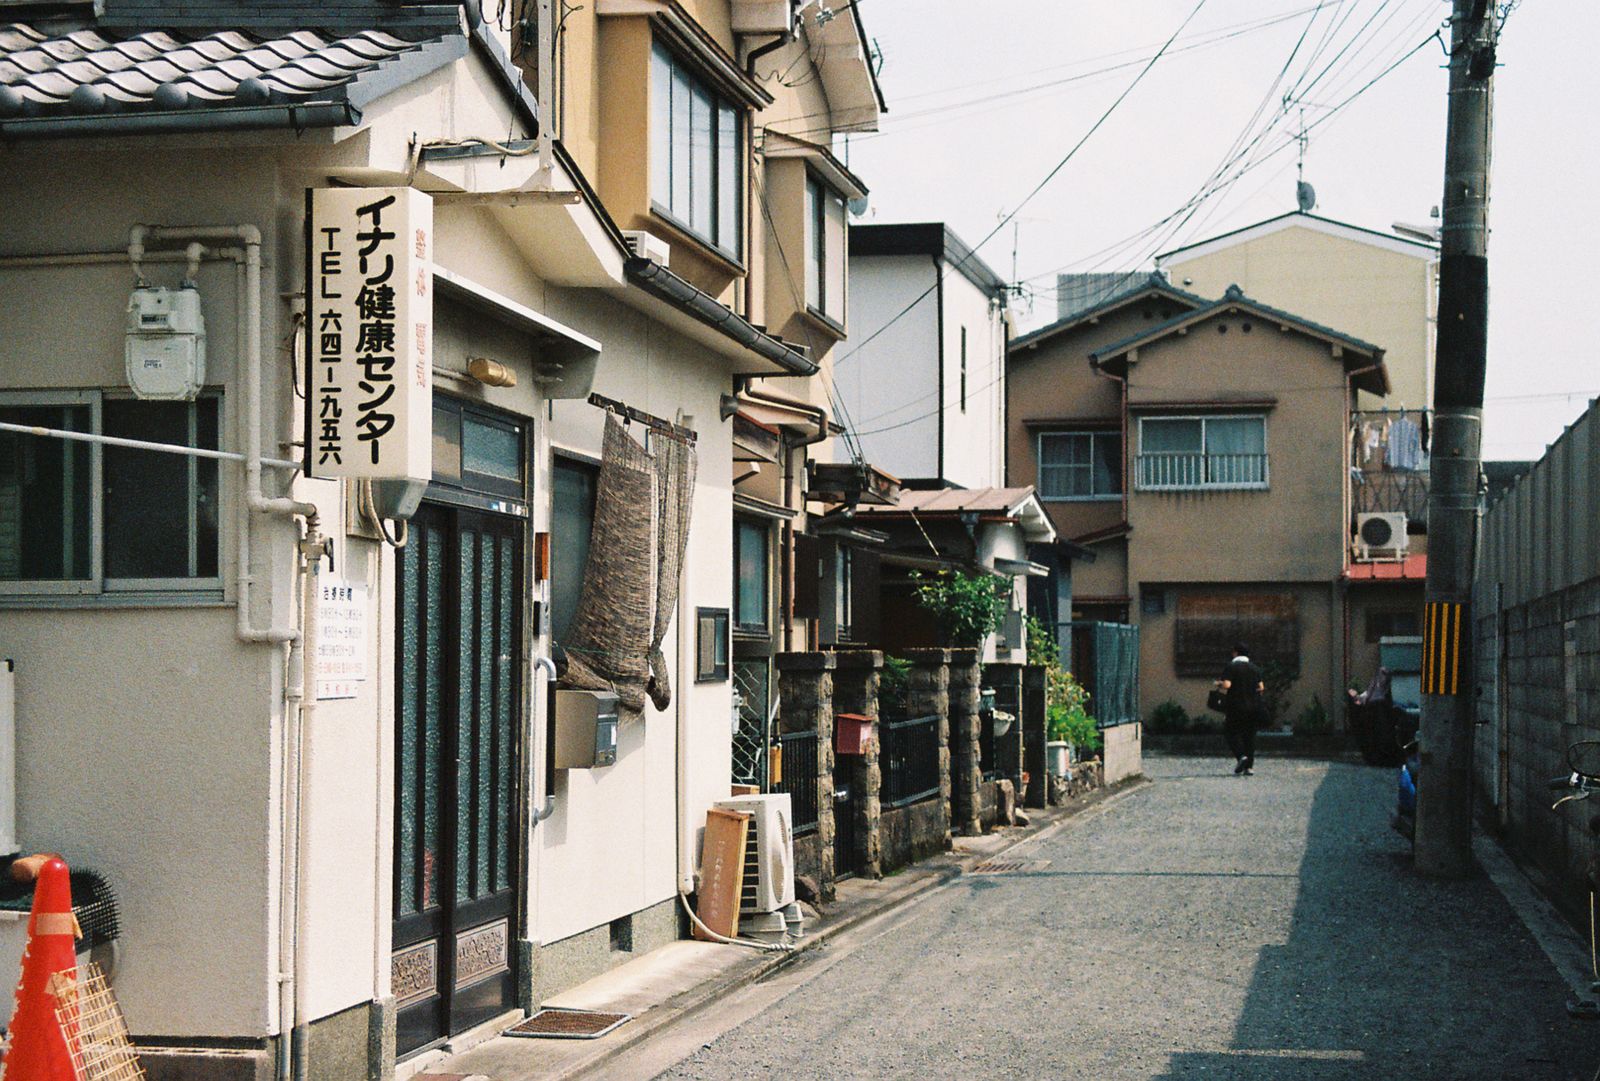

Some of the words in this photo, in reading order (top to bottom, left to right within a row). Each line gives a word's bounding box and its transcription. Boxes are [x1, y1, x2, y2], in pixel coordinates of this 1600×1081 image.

[320, 227, 342, 299] TEL
[355, 195, 396, 464] イナリ健康センター
